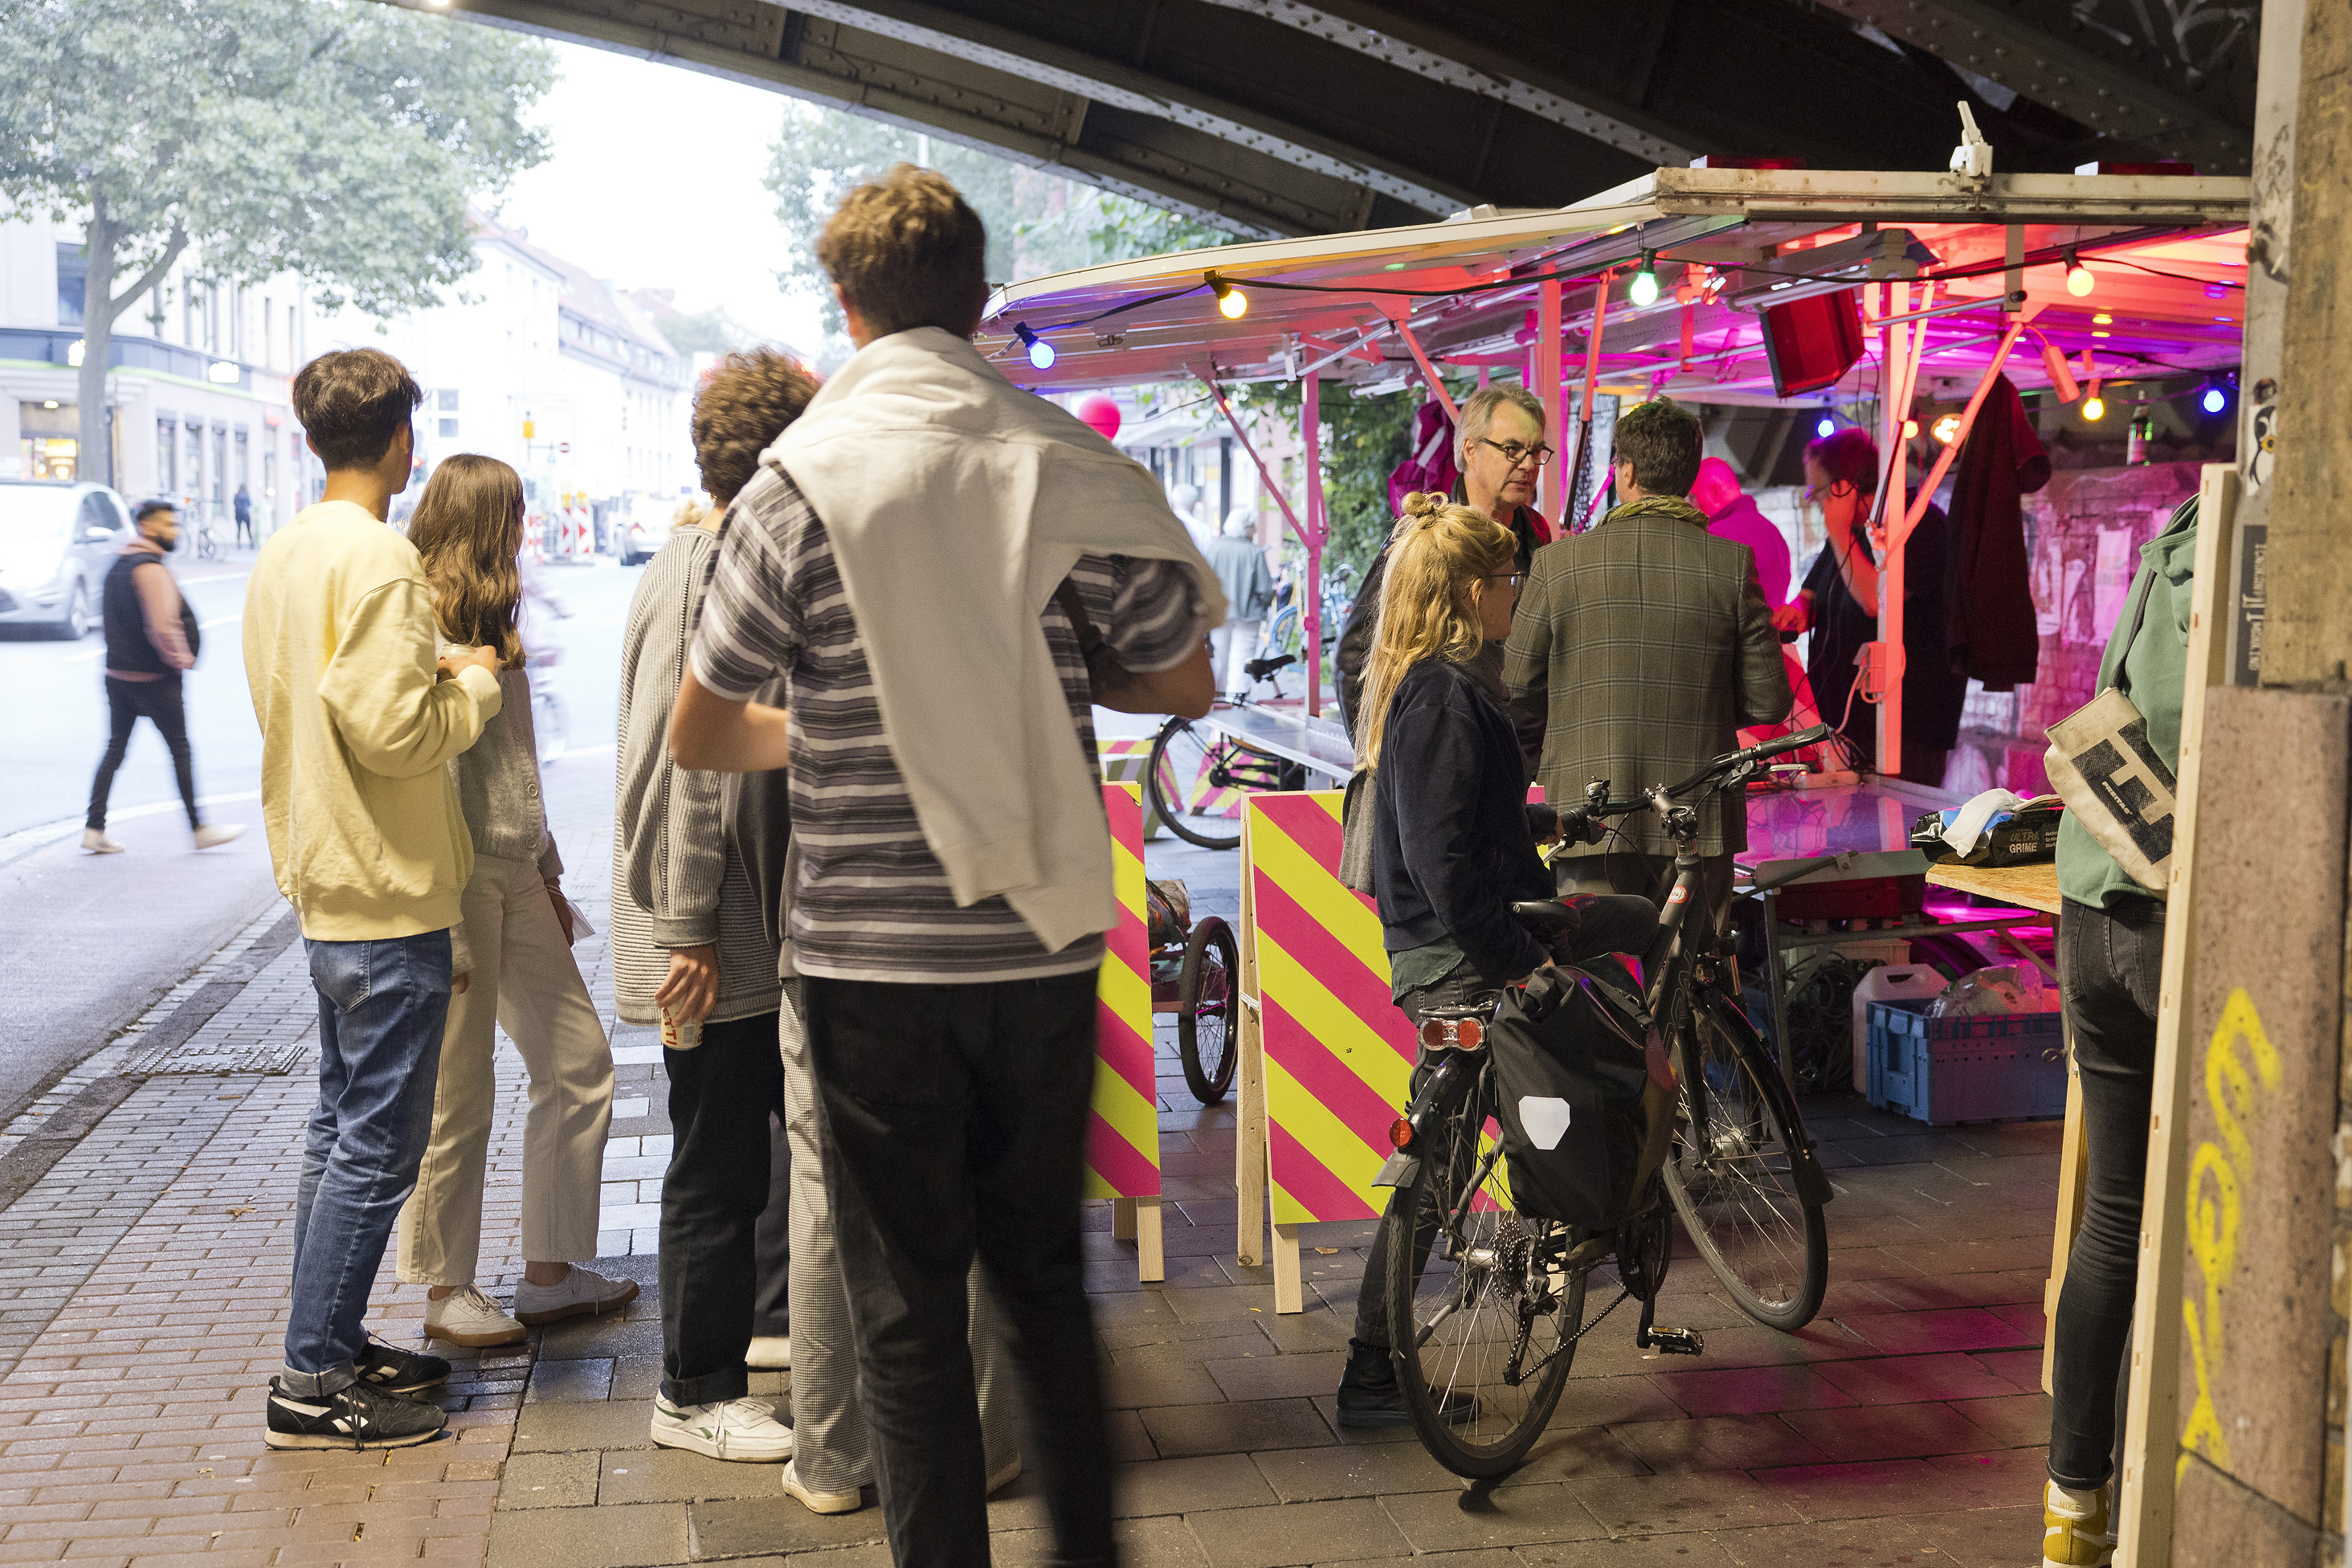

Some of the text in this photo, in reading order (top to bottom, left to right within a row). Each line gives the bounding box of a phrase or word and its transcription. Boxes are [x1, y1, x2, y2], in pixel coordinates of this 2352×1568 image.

[2101, 781, 2132, 815] FREITAG
[2009, 842, 2038, 854] GRIME
[2010, 831, 2040, 843] ULTRA
[663, 1007, 677, 1046] ETTI
